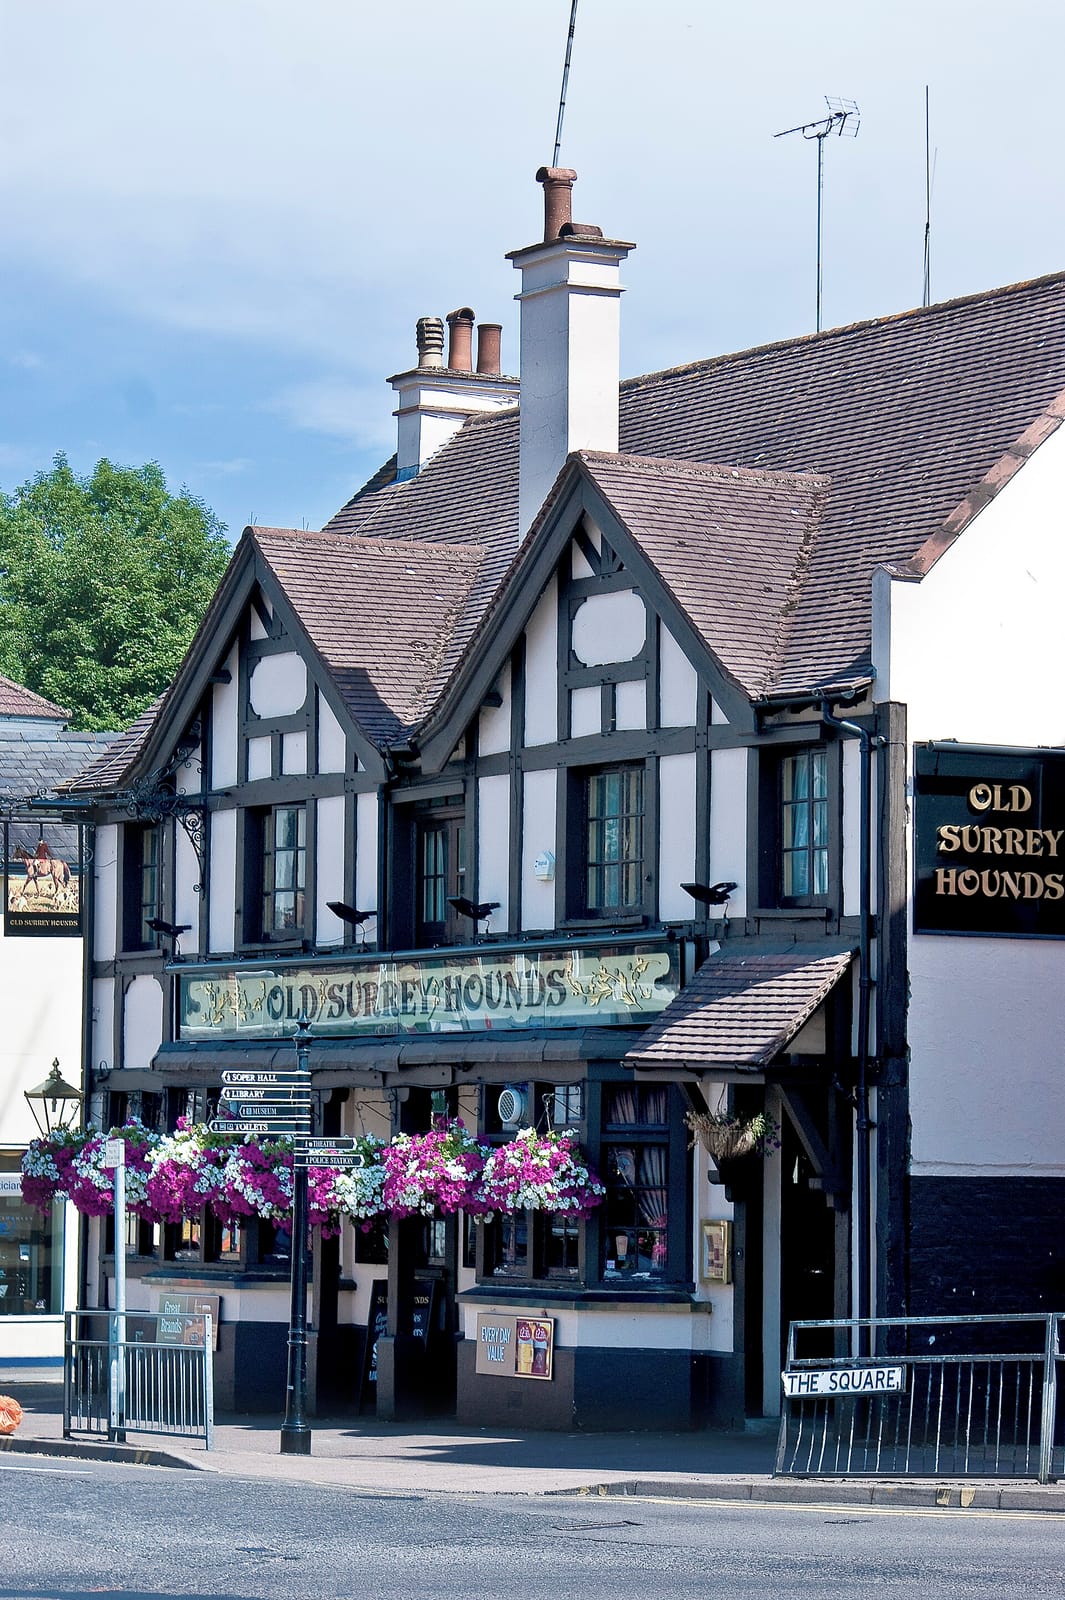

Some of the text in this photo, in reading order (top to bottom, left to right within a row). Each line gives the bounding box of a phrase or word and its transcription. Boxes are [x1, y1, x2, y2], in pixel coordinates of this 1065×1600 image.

[969, 783, 1032, 812] OLD
[939, 824, 1064, 857] SURREY
[935, 867, 1065, 900] HOUNDS
[50, 919, 78, 927] HOUNDS
[267, 968, 567, 1020] OLD SURREY HOUNDS
[232, 1073, 277, 1082] SOPER HALL
[231, 1090, 265, 1098] LIBRARY
[253, 1107, 277, 1115] MUSEUM
[234, 1123, 268, 1131] TOILETS
[313, 1140, 336, 1148] THEATRE
[310, 1156, 354, 1165] POLICE STATION
[481, 1326, 511, 1344] EVERY DAY
[487, 1345, 505, 1362] VALUE
[786, 1369, 897, 1393] THE SQUARE
